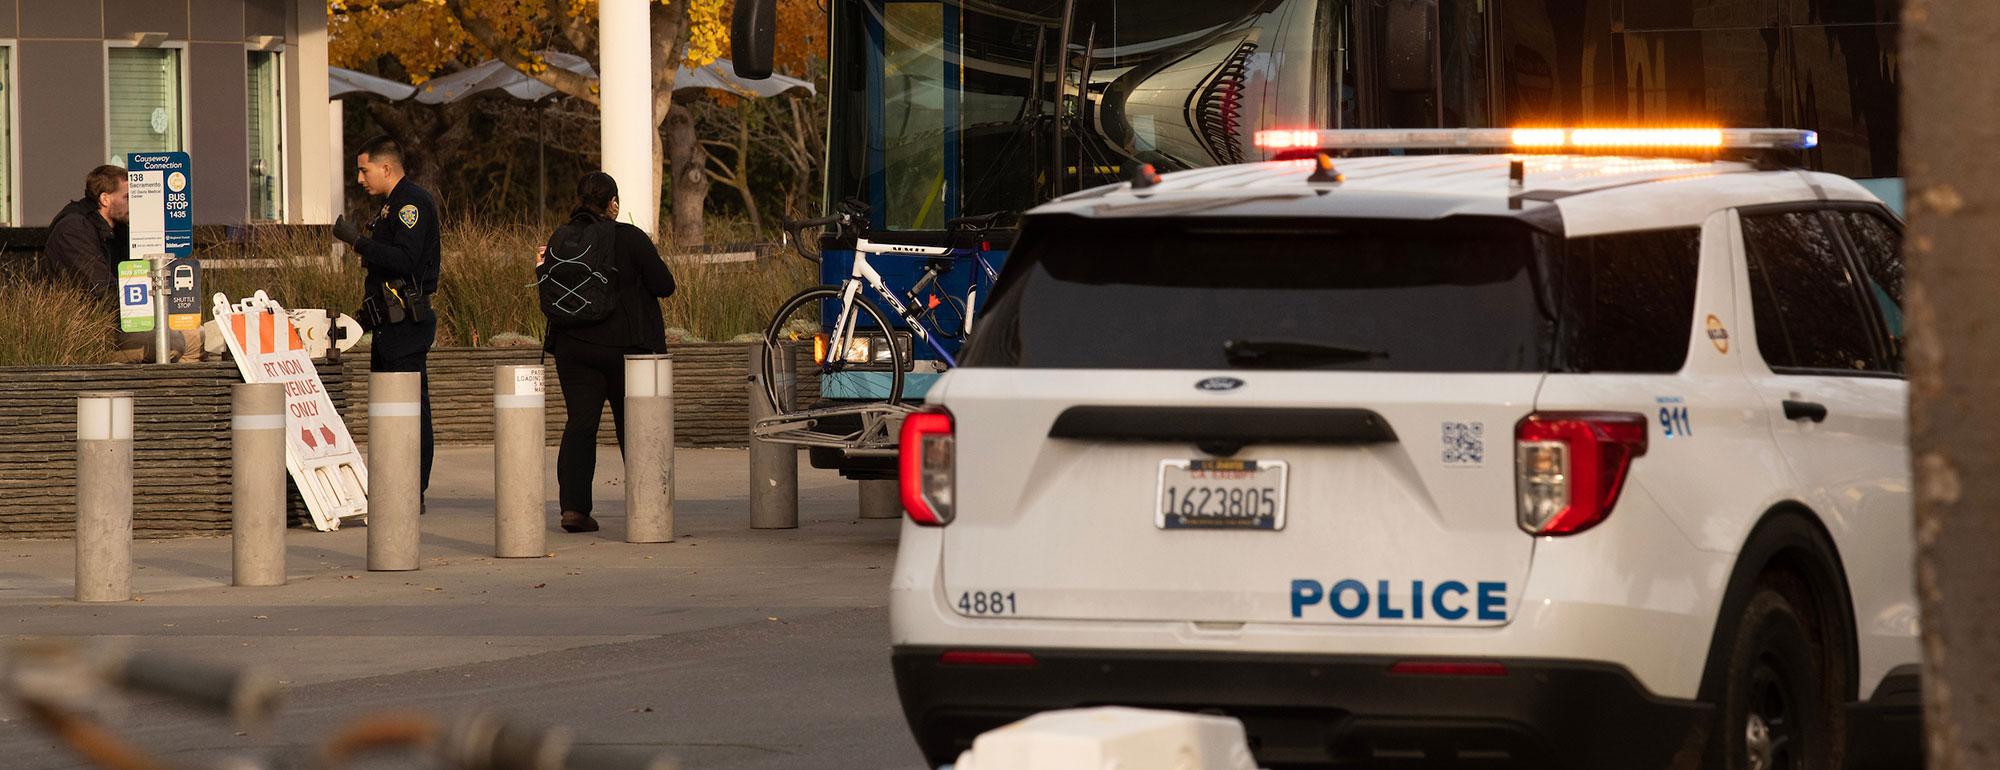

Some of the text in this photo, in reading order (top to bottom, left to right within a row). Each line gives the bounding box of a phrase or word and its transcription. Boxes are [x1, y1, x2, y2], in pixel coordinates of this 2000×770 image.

[134, 155, 170, 163] Causeway
[129, 173, 144, 182] 138
[166, 201, 189, 210] STOP
[168, 193, 186, 201] BUS
[129, 287, 142, 303] B
[263, 359, 304, 377] RT NON
[290, 399, 319, 418] ONLY
[1660, 407, 1691, 436] 911
[1168, 487, 1276, 517] 1623805
[958, 591, 1016, 614] 4881
[1291, 579, 1507, 620] POLICE
